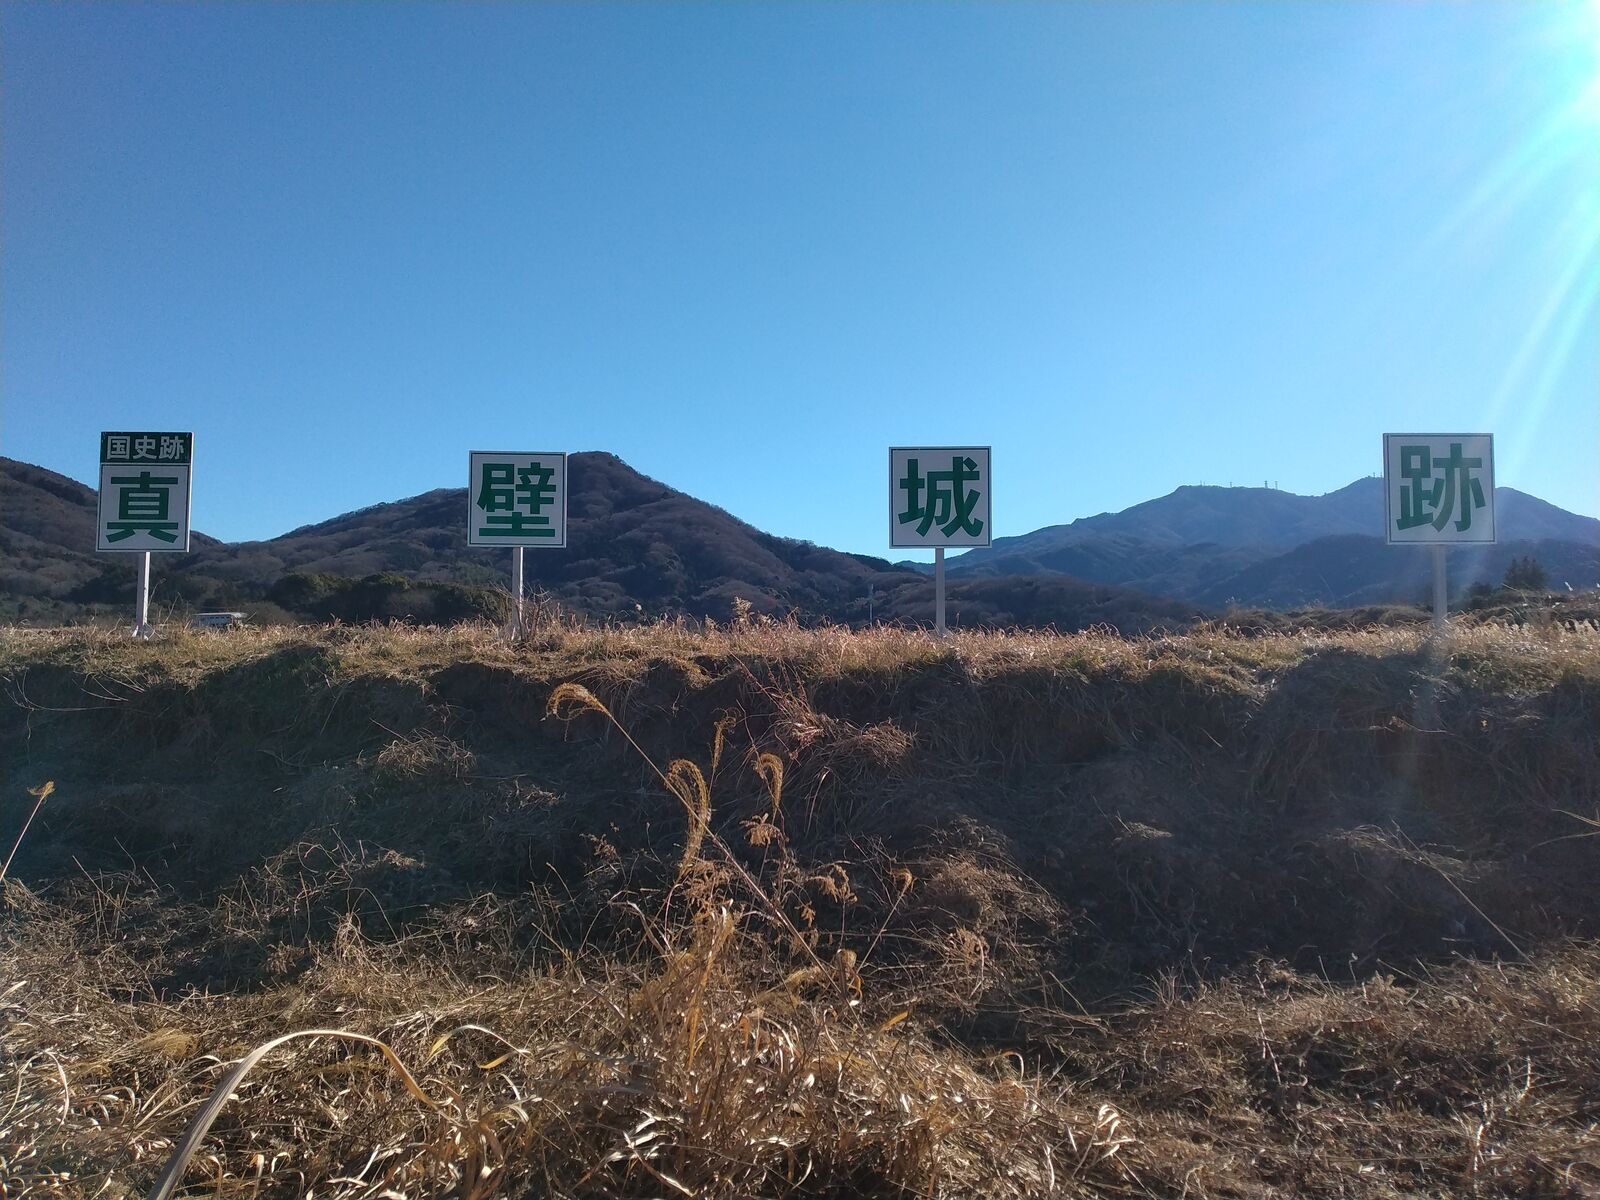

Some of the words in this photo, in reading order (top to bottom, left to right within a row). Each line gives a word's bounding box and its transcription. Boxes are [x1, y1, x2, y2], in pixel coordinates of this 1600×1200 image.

[107, 436, 184, 459] 国史跡
[106, 472, 178, 543] 真
[477, 462, 556, 537] 壁
[898, 456, 984, 538] 城
[1396, 443, 1486, 532] 跡
